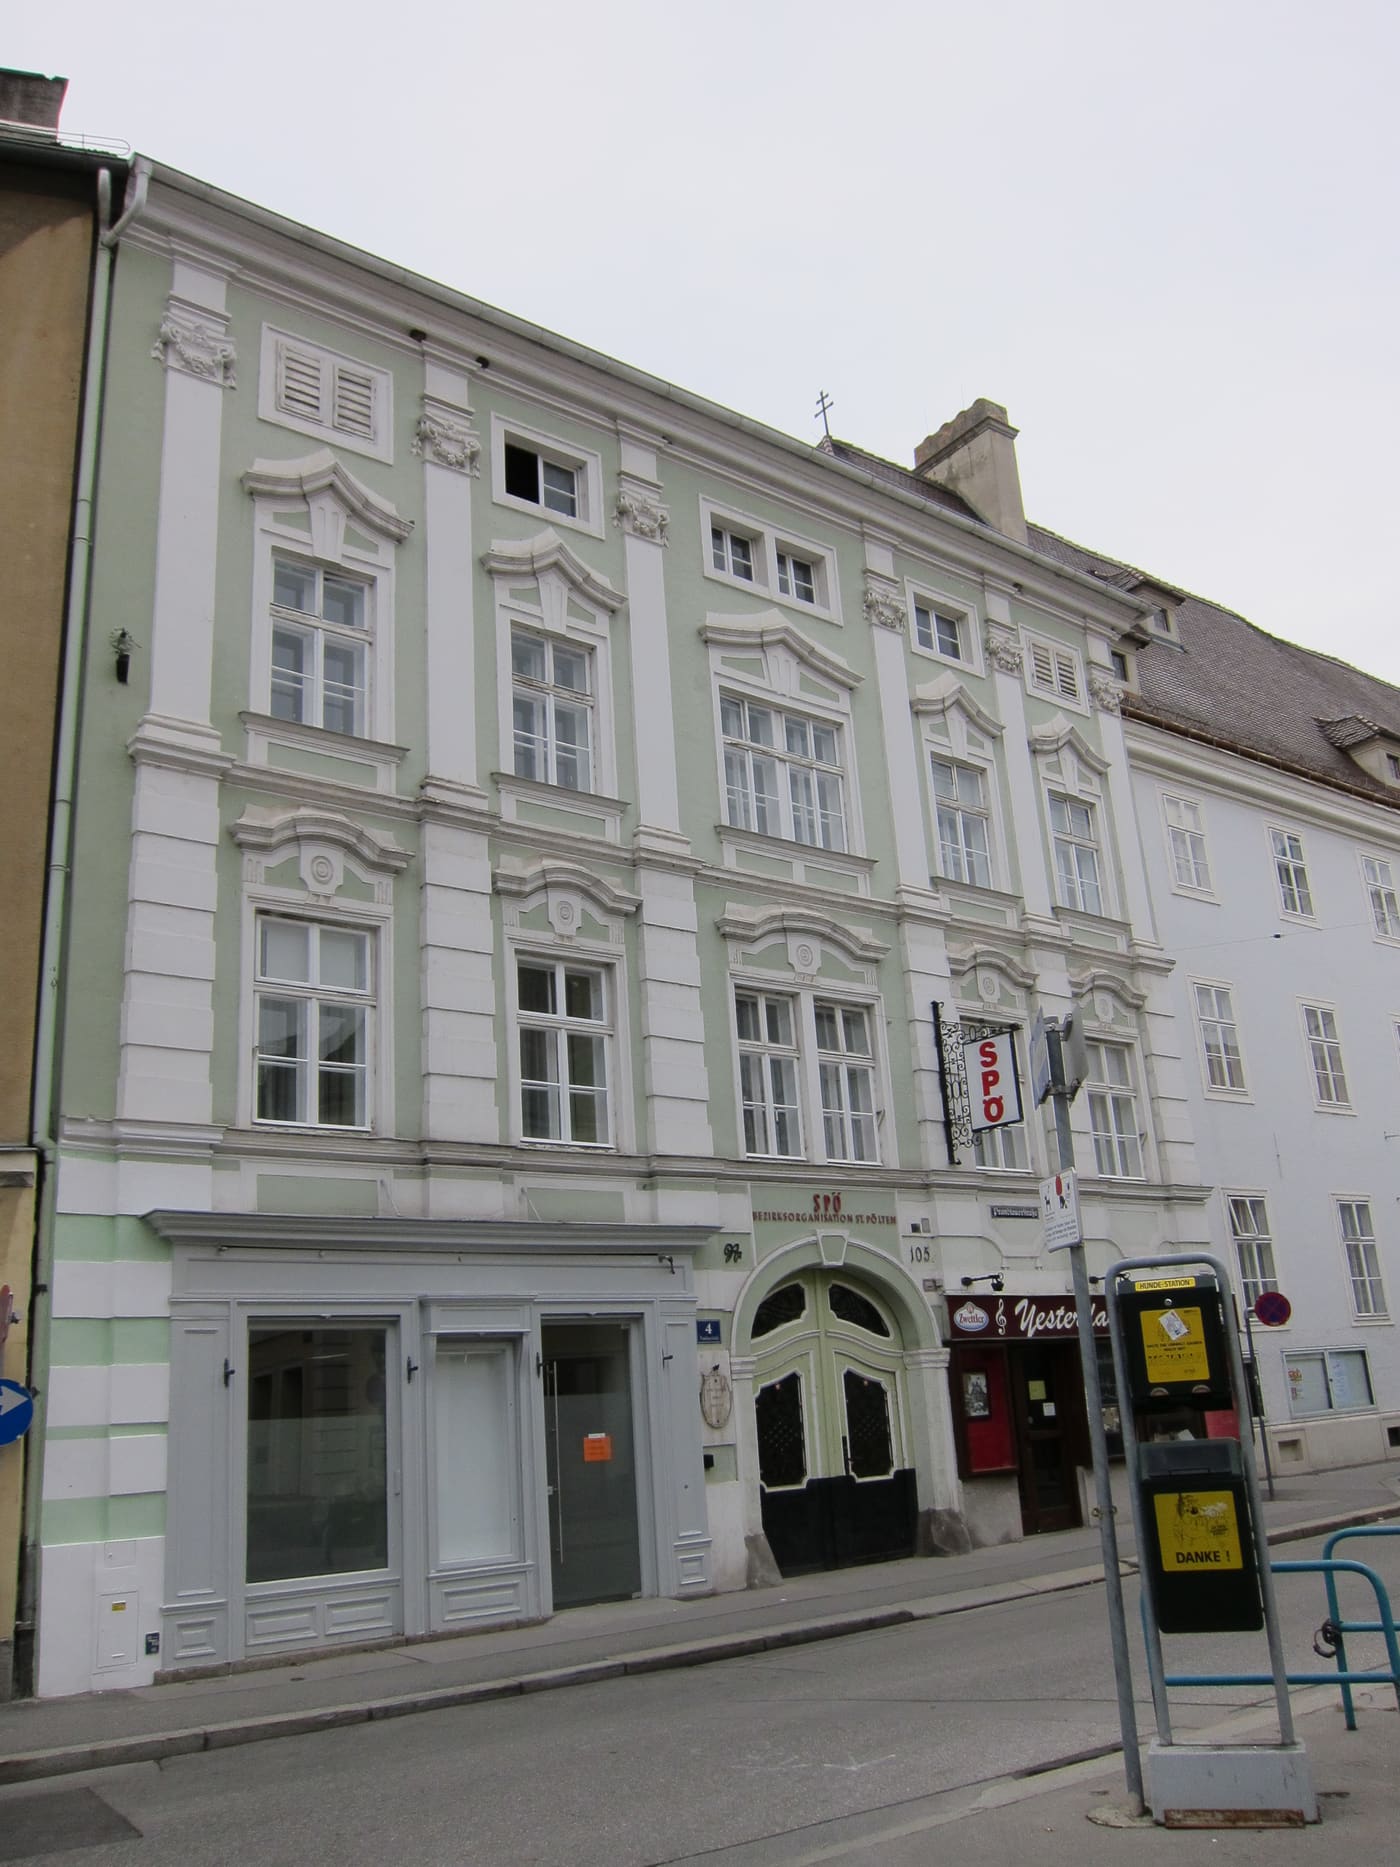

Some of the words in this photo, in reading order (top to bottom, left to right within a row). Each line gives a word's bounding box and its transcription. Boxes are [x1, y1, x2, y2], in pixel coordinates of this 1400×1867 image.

[979, 1041, 1004, 1122] SPÖ
[812, 1192, 842, 1213] SPÖ
[752, 1211, 853, 1224] BEZIRKSORGANISATION
[866, 1213, 896, 1225] PÖLTEN
[1139, 1279, 1190, 1289] HUNDE-STATION
[1014, 1298, 1110, 1338] Yestera
[704, 1322, 713, 1335] 4
[1175, 1550, 1222, 1564] DANKE
[1225, 1550, 1231, 1562] !
